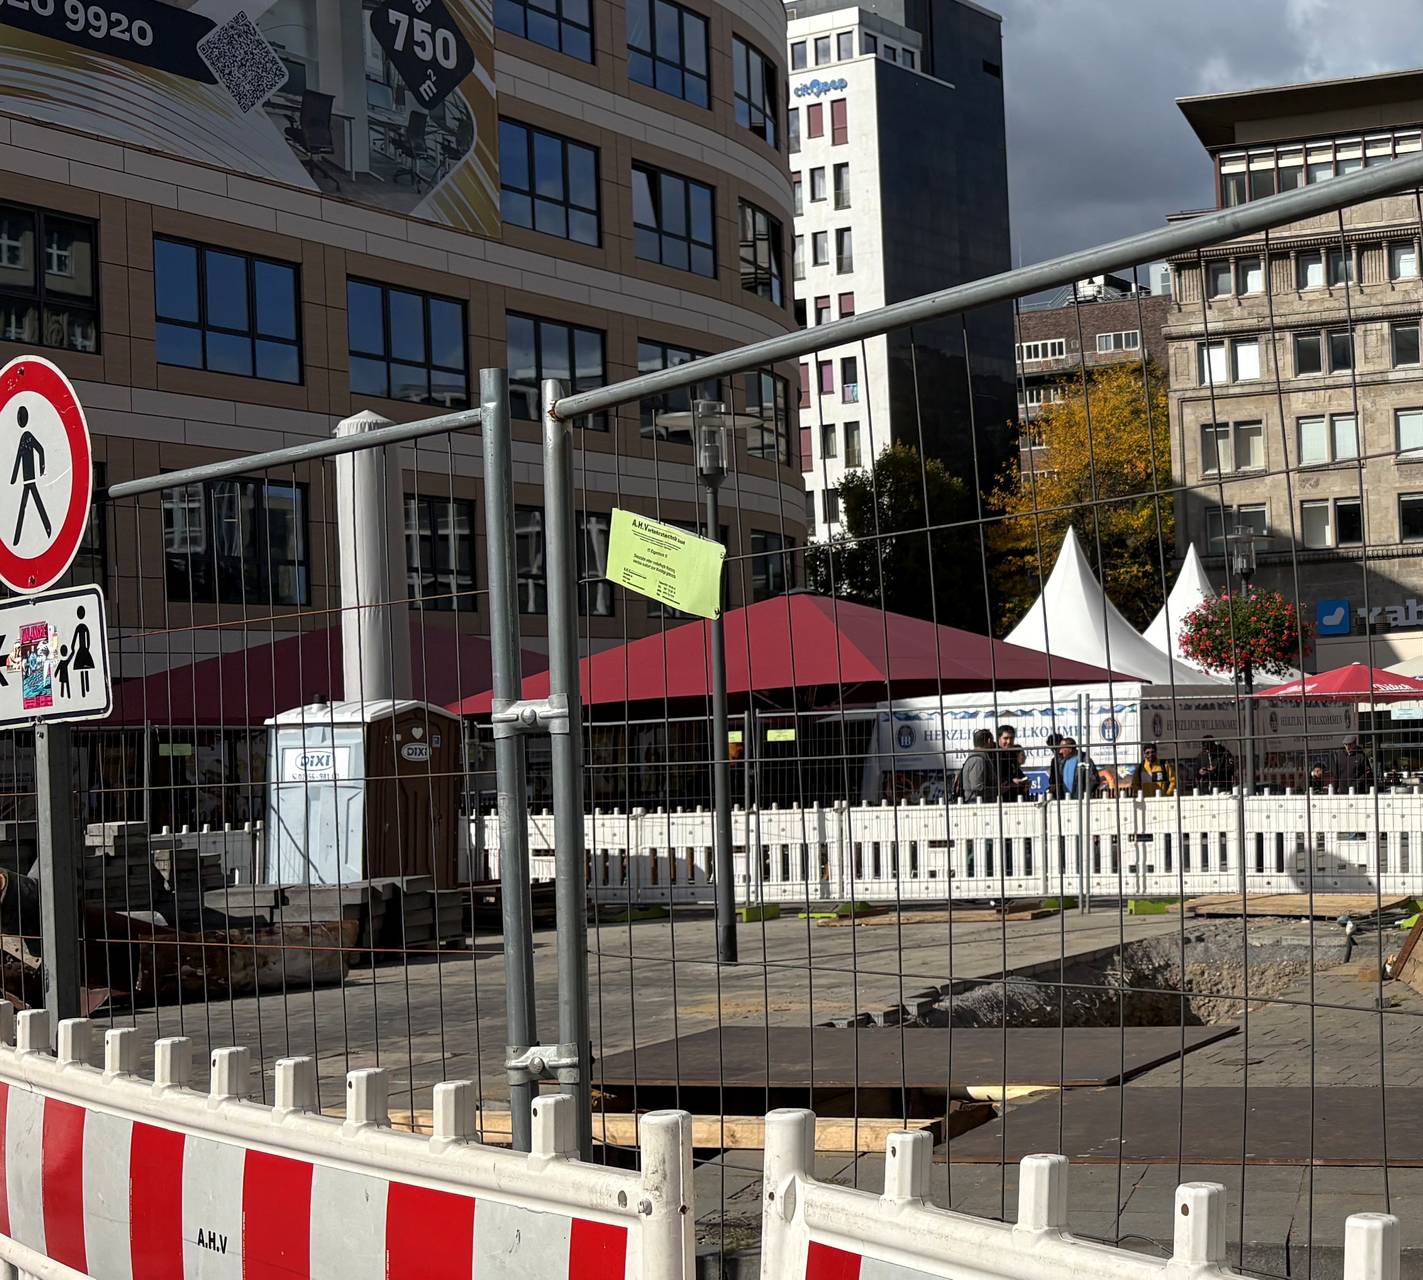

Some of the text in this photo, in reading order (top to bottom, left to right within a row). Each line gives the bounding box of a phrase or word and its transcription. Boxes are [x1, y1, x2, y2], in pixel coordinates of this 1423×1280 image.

[64, 0, 154, 47] 9920
[388, 8, 457, 69] 750
[197, 1228, 228, 1254] A.H.V
